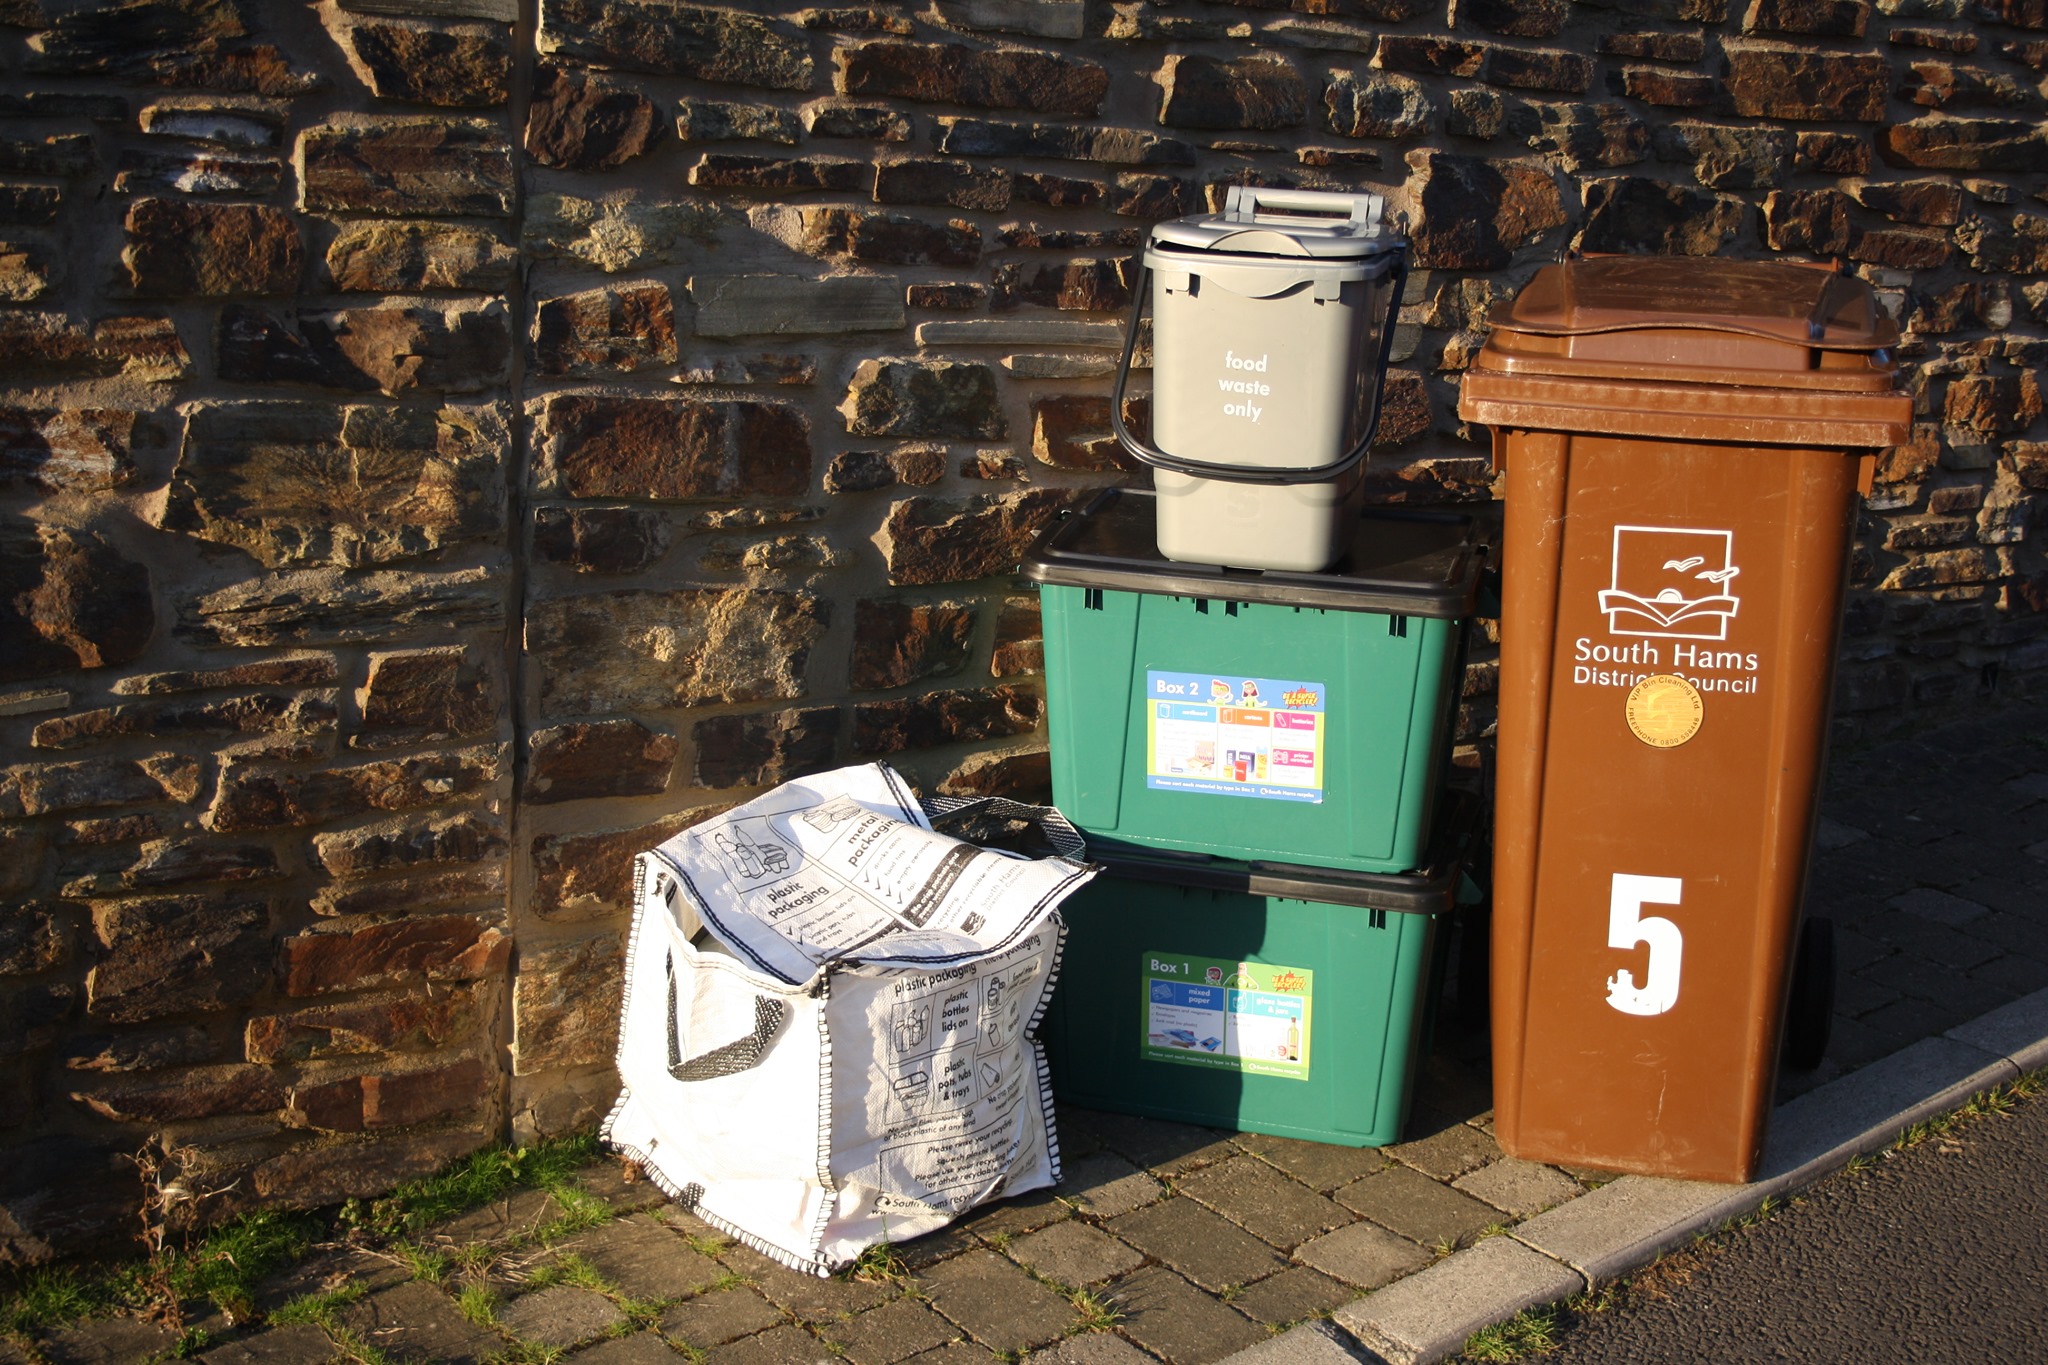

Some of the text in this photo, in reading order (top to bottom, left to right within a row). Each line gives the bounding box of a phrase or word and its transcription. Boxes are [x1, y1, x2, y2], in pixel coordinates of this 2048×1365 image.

[1225, 350, 1268, 373] food
[1218, 379, 1271, 396] waste
[1223, 399, 1262, 423] only
[1574, 637, 1758, 671] South Hams
[1156, 679, 1199, 696] Box 2
[1573, 665, 1656, 687] Distric
[1630, 687, 1642, 701] VIP
[1642, 679, 1656, 689] Bin
[1658, 676, 1693, 696] Cleaning
[1628, 707, 1658, 744] FREEPHONE
[1660, 737, 1679, 746] 0800
[847, 814, 880, 844] metal
[847, 819, 906, 868] packagin
[874, 837, 902, 870] drinks cans
[884, 849, 906, 877] food tins
[896, 840, 933, 885] empty aerosols
[910, 852, 960, 914] No crisp packets and
[981, 863, 1021, 908] South Hams
[1005, 866, 1027, 888] Council
[767, 881, 804, 904] plastic
[768, 886, 830, 920] packaging
[847, 894, 856, 902] on
[918, 900, 934, 919] sweet
[932, 872, 955, 901] wrappers
[950, 905, 963, 923] other
[963, 872, 987, 905] recyclable
[1605, 872, 1683, 1016] 5
[1151, 958, 1189, 975] Box 1
[895, 963, 977, 998] plastic packaging
[944, 989, 969, 1008] plastic
[1188, 988, 1211, 997] mixed
[1188, 997, 1211, 1005] paper
[941, 1003, 970, 1018] bottles
[941, 1019, 968, 1033] lids on
[945, 1056, 965, 1076] plastic
[958, 1068, 972, 1082] tubs
[943, 1085, 970, 1101] & trays
[987, 1095, 997, 1104] No
[893, 1131, 912, 1140] black
[913, 1126, 937, 1137] plastic
[939, 1124, 947, 1132] of
[948, 1124, 962, 1133] any
[927, 1143, 953, 1154] Please
[954, 1140, 974, 1149] rinse
[975, 1131, 991, 1144] your
[966, 1146, 989, 1161] plastic
[915, 1170, 940, 1182] Please
[941, 1167, 955, 1175] use
[956, 1162, 974, 1173] your
[976, 1152, 1006, 1168] recycling
[925, 1179, 936, 1189] for
[938, 1174, 959, 1186] other
[959, 1164, 998, 1180] recyclable
[892, 1197, 920, 1208] South
[923, 1198, 948, 1211] Hams
